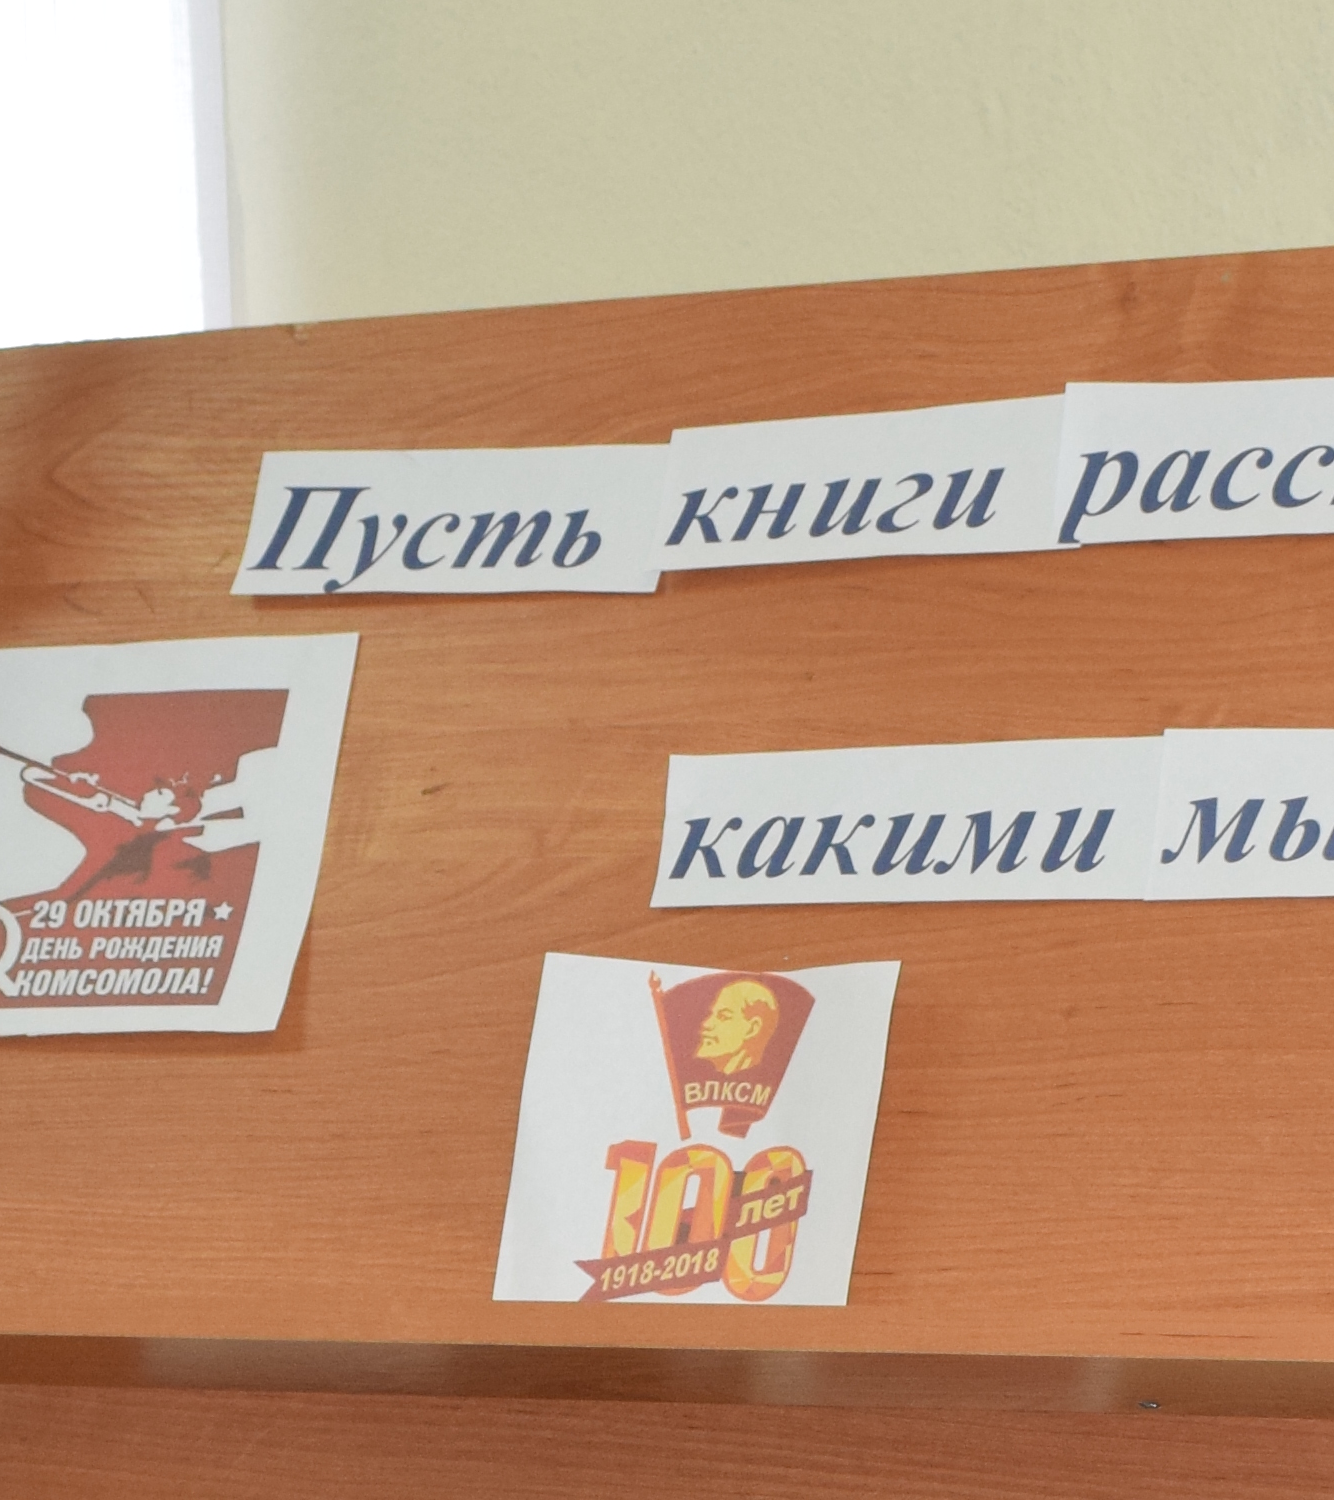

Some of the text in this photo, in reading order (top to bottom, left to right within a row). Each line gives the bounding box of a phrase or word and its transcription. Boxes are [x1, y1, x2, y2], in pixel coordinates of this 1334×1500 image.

[246, 485, 603, 592] Пусть
[665, 466, 1005, 547] книги
[668, 802, 1117, 880] какими
[30, 898, 207, 929] 29 ОКТЯБРЯ
[20, 934, 224, 965] ДЕНЬ РОЖДЕНИЯ
[13, 967, 215, 998] КОМСОМОЛА!
[683, 1080, 772, 1107] ВЛКСМ
[602, 1139, 807, 1303] 100
[735, 1183, 805, 1229] лет
[599, 1247, 720, 1292] 1918-2018
